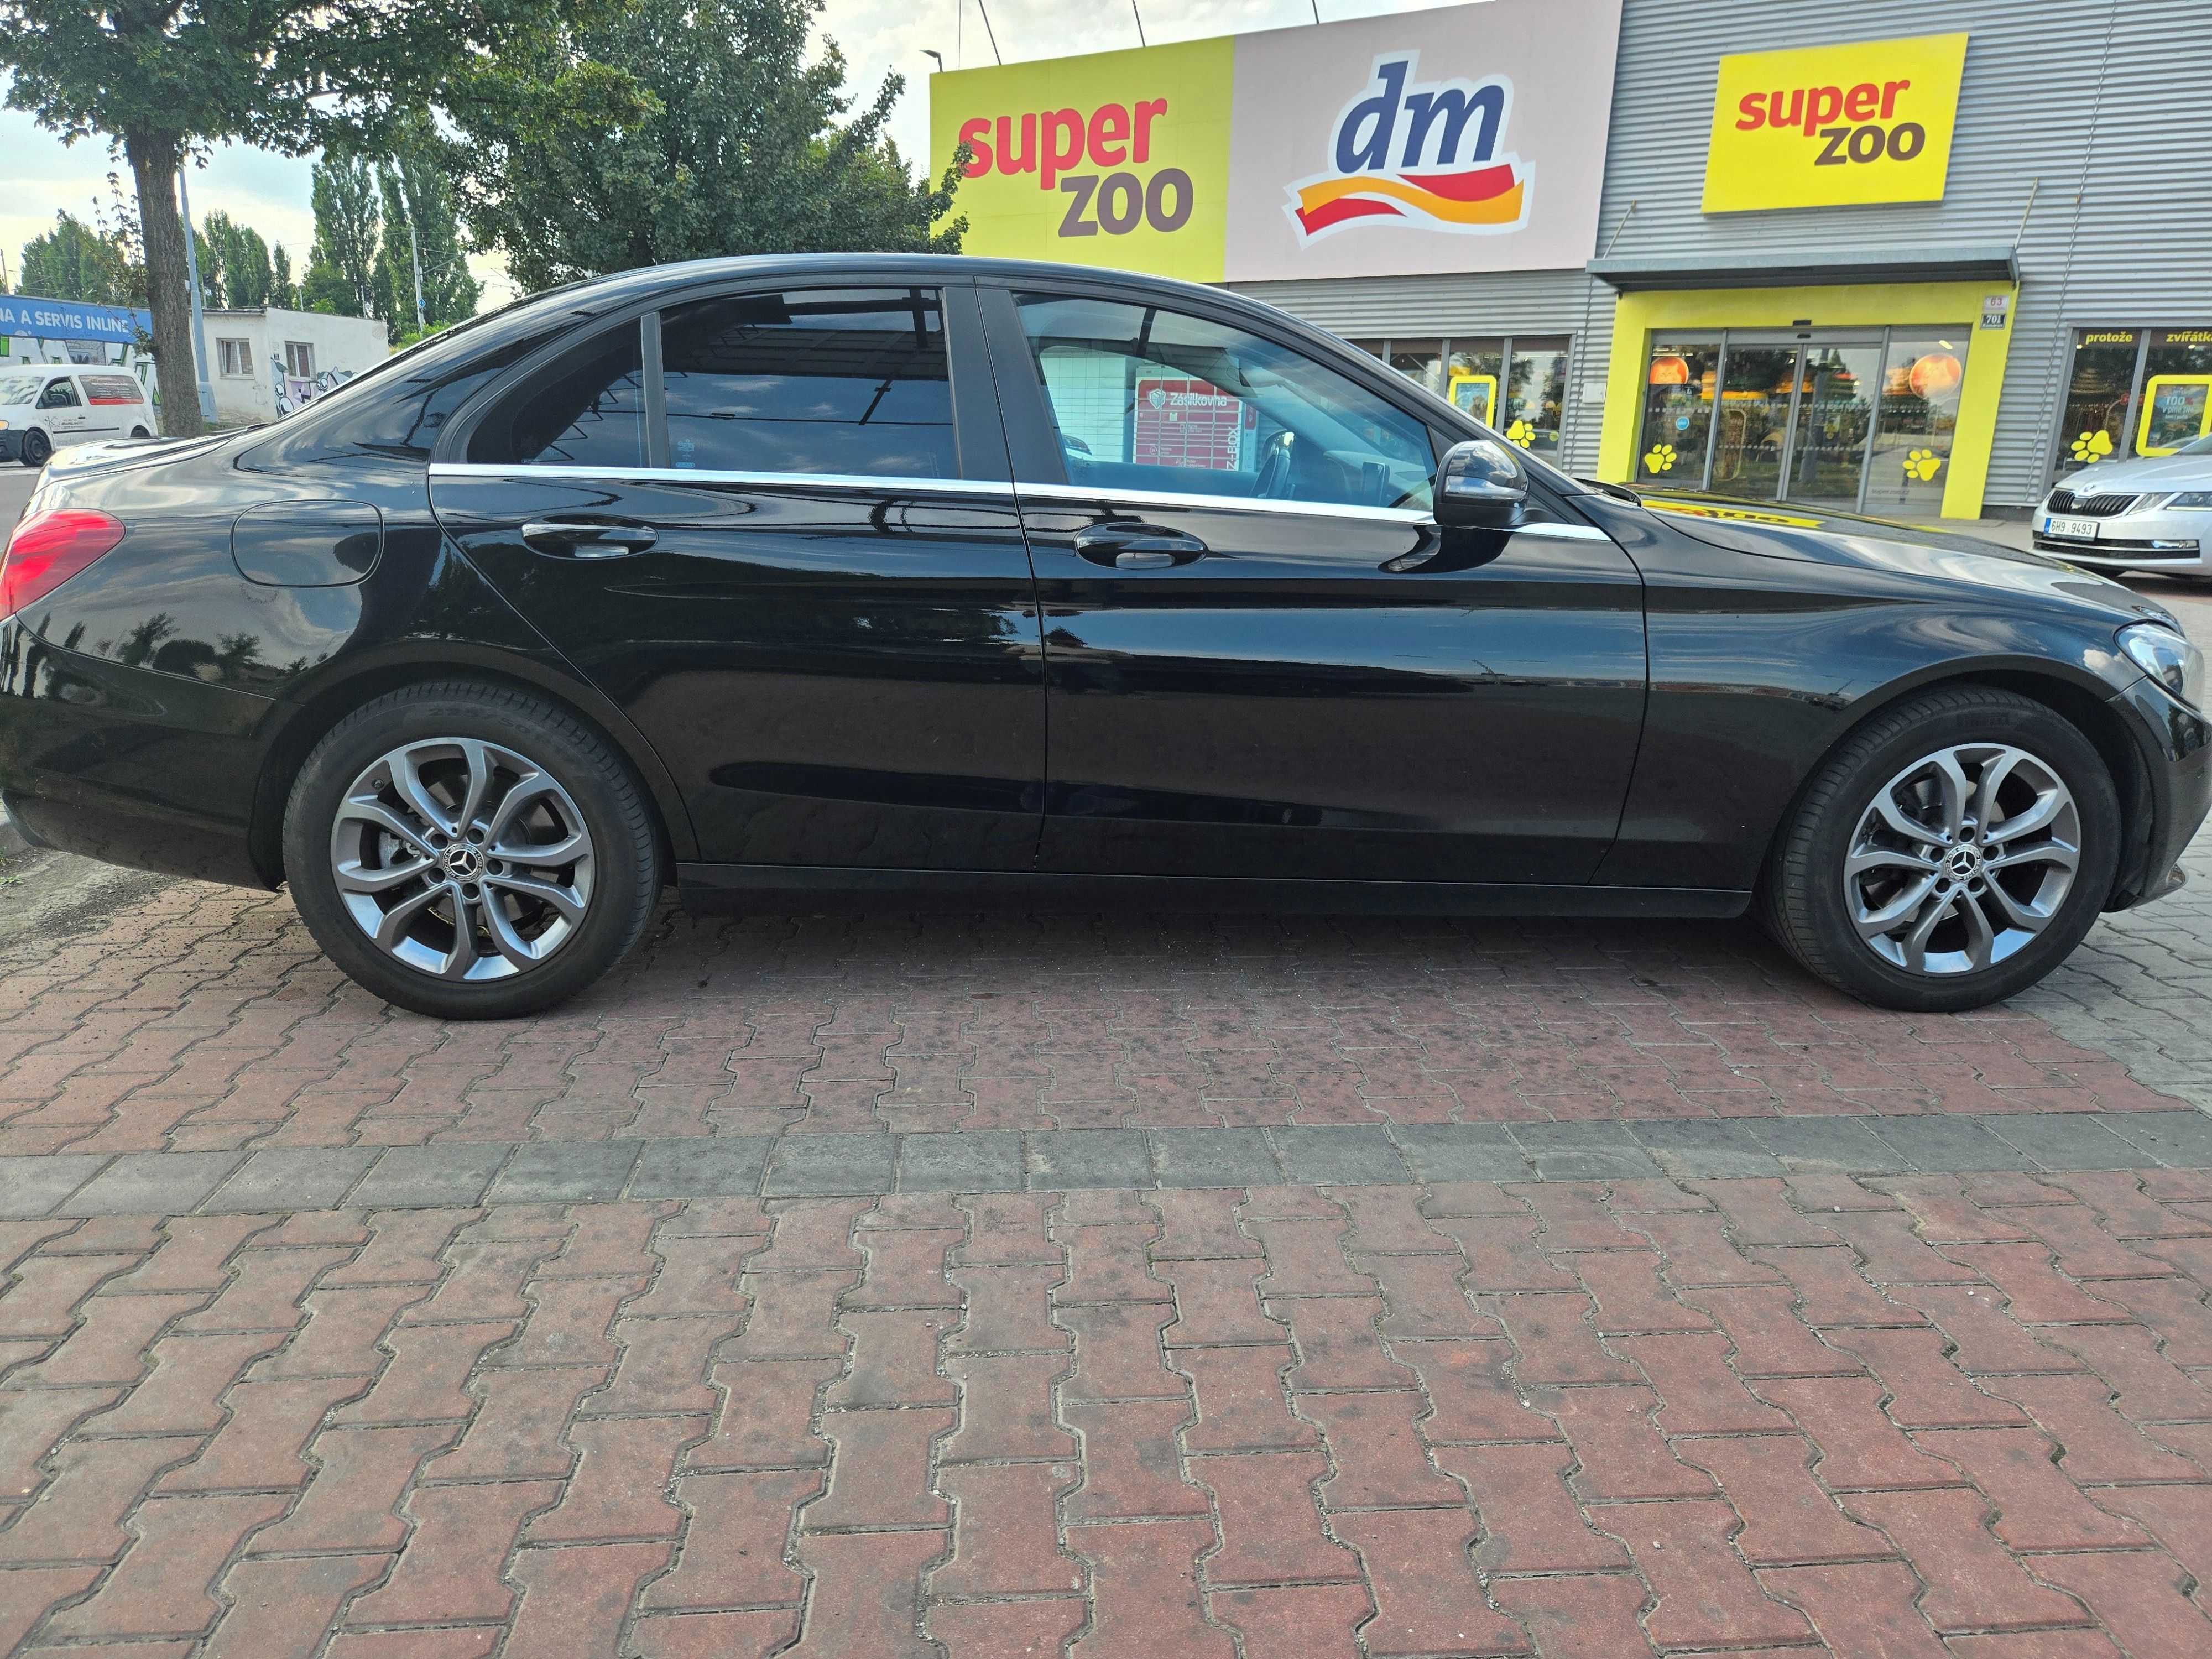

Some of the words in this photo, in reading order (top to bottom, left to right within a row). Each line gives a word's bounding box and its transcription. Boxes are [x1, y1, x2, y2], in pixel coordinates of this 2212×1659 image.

[1336, 61, 1504, 174] dm
[1735, 80, 1910, 137] super
[958, 98, 1168, 190] super
[1814, 122, 1926, 166] zoo
[1058, 168, 1194, 238] zoo
[1991, 298, 2002, 306] 63
[20, 310, 32, 325] A
[35, 311, 82, 330] SERVIS
[86, 315, 129, 333] INLINE
[1986, 315, 2001, 324] 701
[2085, 331, 2133, 345] protože
[2166, 331, 2212, 342] zvířátk
[1170, 393, 1227, 406] Zásilkovna
[1226, 426, 1238, 469] Z-BOX
[2051, 521, 2066, 533] 6H9
[2070, 523, 2093, 535] 9493
